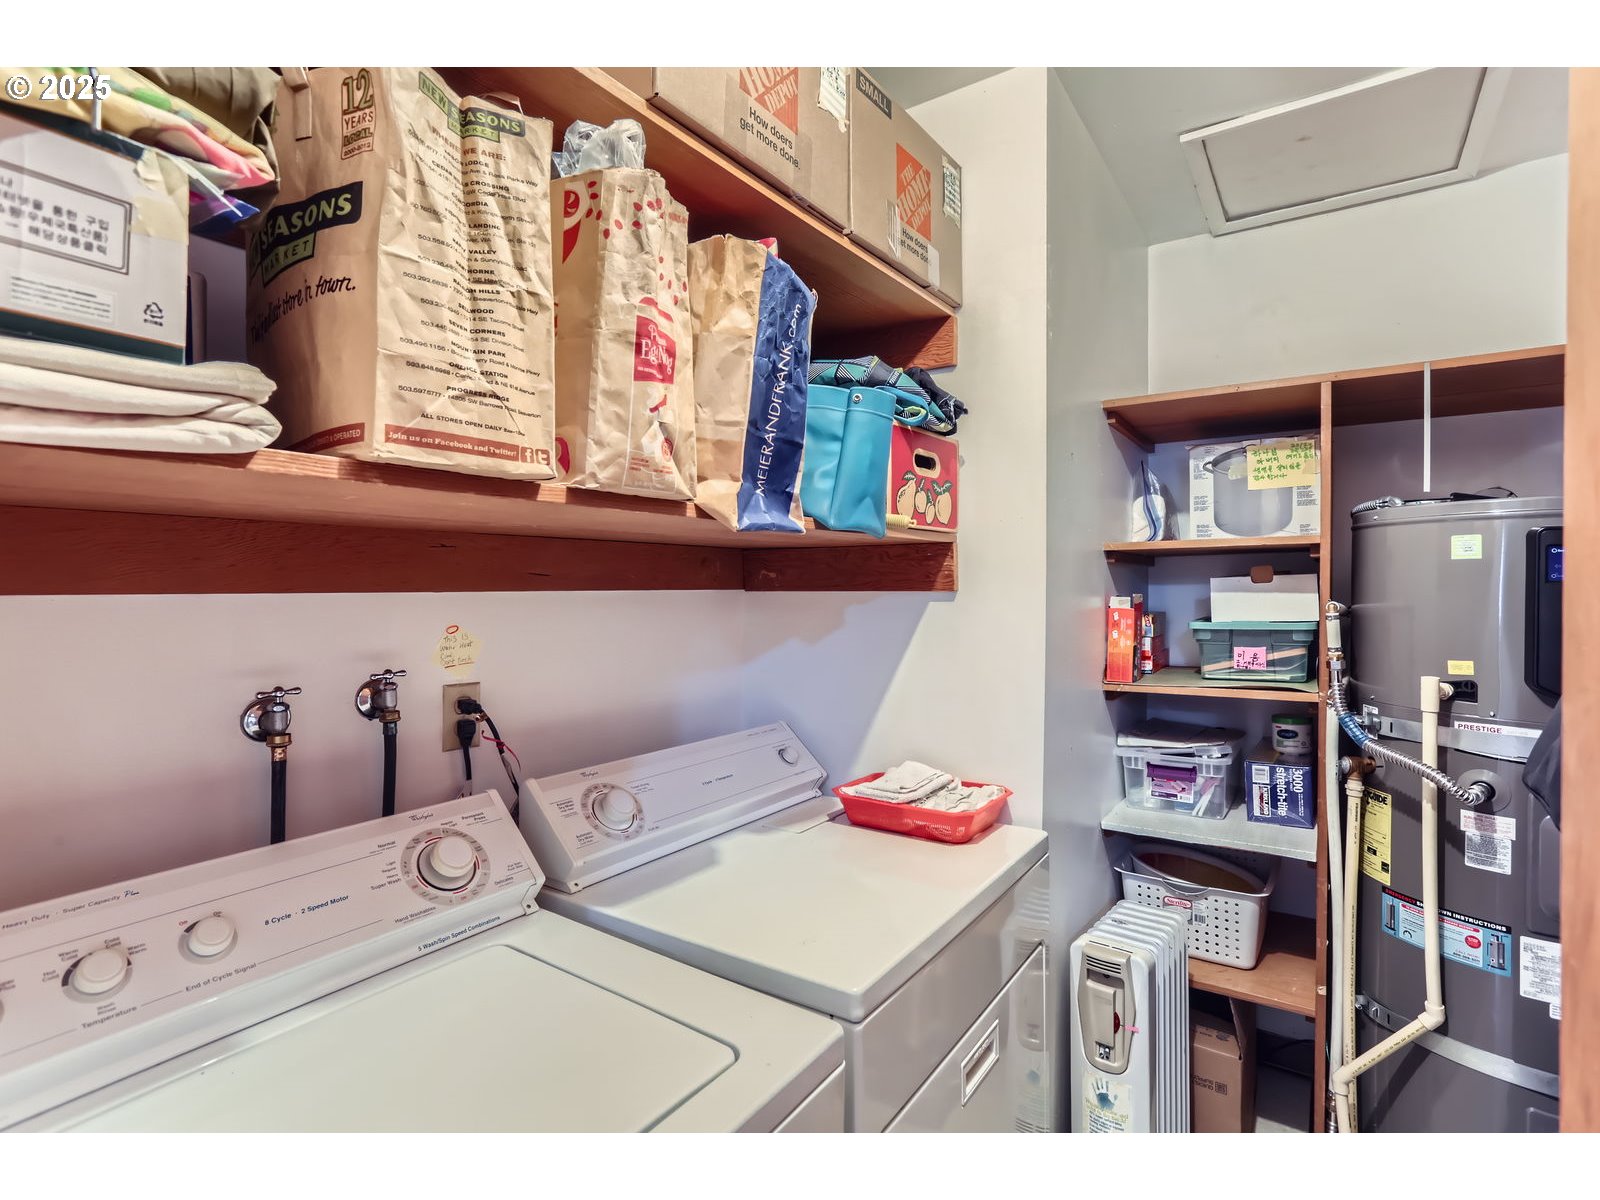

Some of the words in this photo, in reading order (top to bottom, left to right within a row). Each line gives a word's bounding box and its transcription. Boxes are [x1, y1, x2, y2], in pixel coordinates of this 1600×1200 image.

[342, 68, 373, 115] 12
[860, 76, 889, 112] SMALL
[421, 78, 448, 108] NEW
[450, 106, 522, 133] SEASONS
[344, 110, 374, 130] YEARS
[749, 106, 768, 129] How
[770, 124, 793, 149] doers
[463, 147, 477, 156] WE
[481, 149, 506, 161] ARE:
[740, 118, 754, 136] get
[756, 130, 778, 152] more
[780, 146, 800, 170] done.
[262, 193, 352, 250] SEASONS
[902, 228, 914, 242] How
[315, 274, 357, 298] town.
[470, 328, 506, 338] CORNERS
[488, 350, 506, 358] PARK
[480, 369, 508, 379] STATION
[756, 304, 801, 497] MEIERANDFRANK.com
[420, 412, 434, 421] ALL
[436, 415, 463, 426] STORES
[464, 420, 483, 430] OPEN
[485, 423, 502, 433] DAILY
[388, 431, 408, 441] Join
[409, 434, 420, 443] us
[422, 436, 432, 444] on
[434, 438, 473, 451] Facebook
[473, 445, 488, 453] and
[1457, 723, 1502, 733] PRESTIGE
[1276, 767, 1288, 816] stretch-tite
[1292, 768, 1303, 793] 3000
[271, 913, 292, 924] Cycle
[307, 901, 329, 912] Speed
[330, 895, 349, 905] Motor
[423, 935, 450, 949] Wash/Spin
[451, 928, 467, 939] Speed
[468, 916, 500, 932] Combinations
[1453, 913, 1508, 932] INSTRUCTIONS
[185, 982, 201, 992] End
[212, 972, 233, 982] Cycle
[234, 962, 257, 975] Signal
[81, 1006, 137, 1028] Temperature
